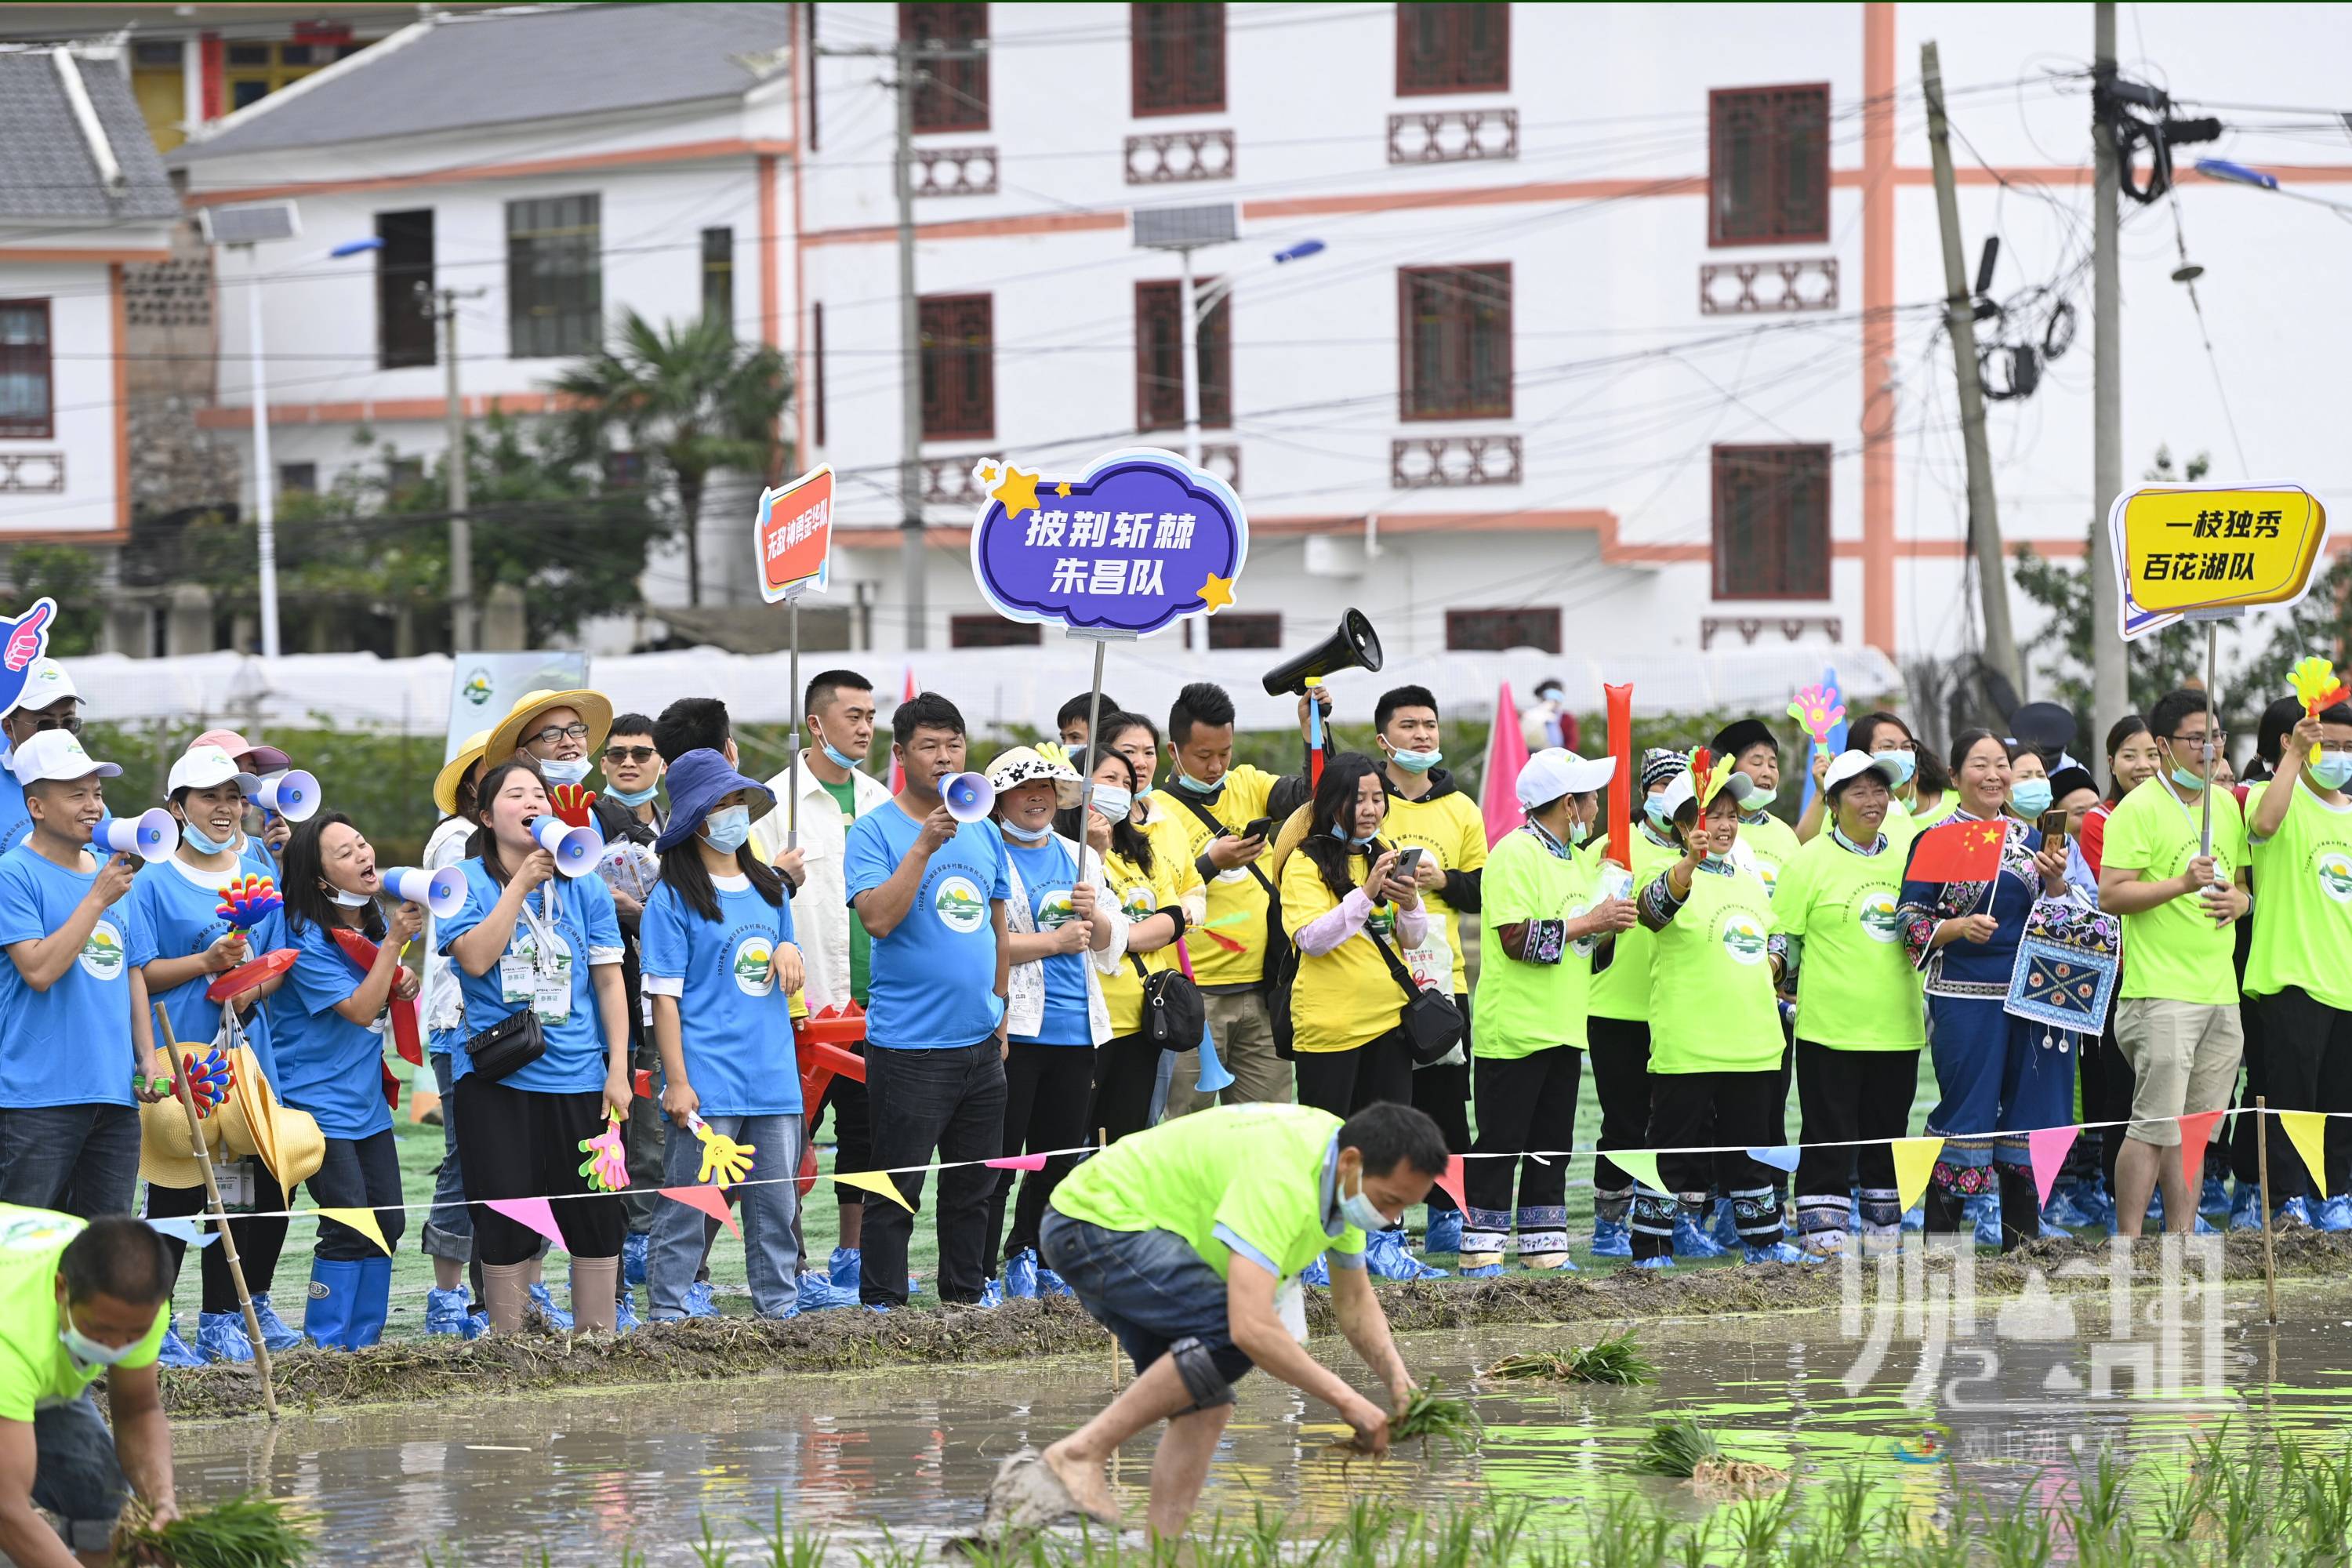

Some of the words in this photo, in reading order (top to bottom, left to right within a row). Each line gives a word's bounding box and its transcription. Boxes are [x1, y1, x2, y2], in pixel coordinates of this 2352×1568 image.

[767, 498, 828, 562] 无敌神勇金华队
[1025, 510, 1196, 549] 披荆斩棘
[2165, 510, 2282, 539] 一枝独秀
[1049, 557, 1164, 596] 朱昌队
[2143, 552, 2256, 581] 百花湖队
